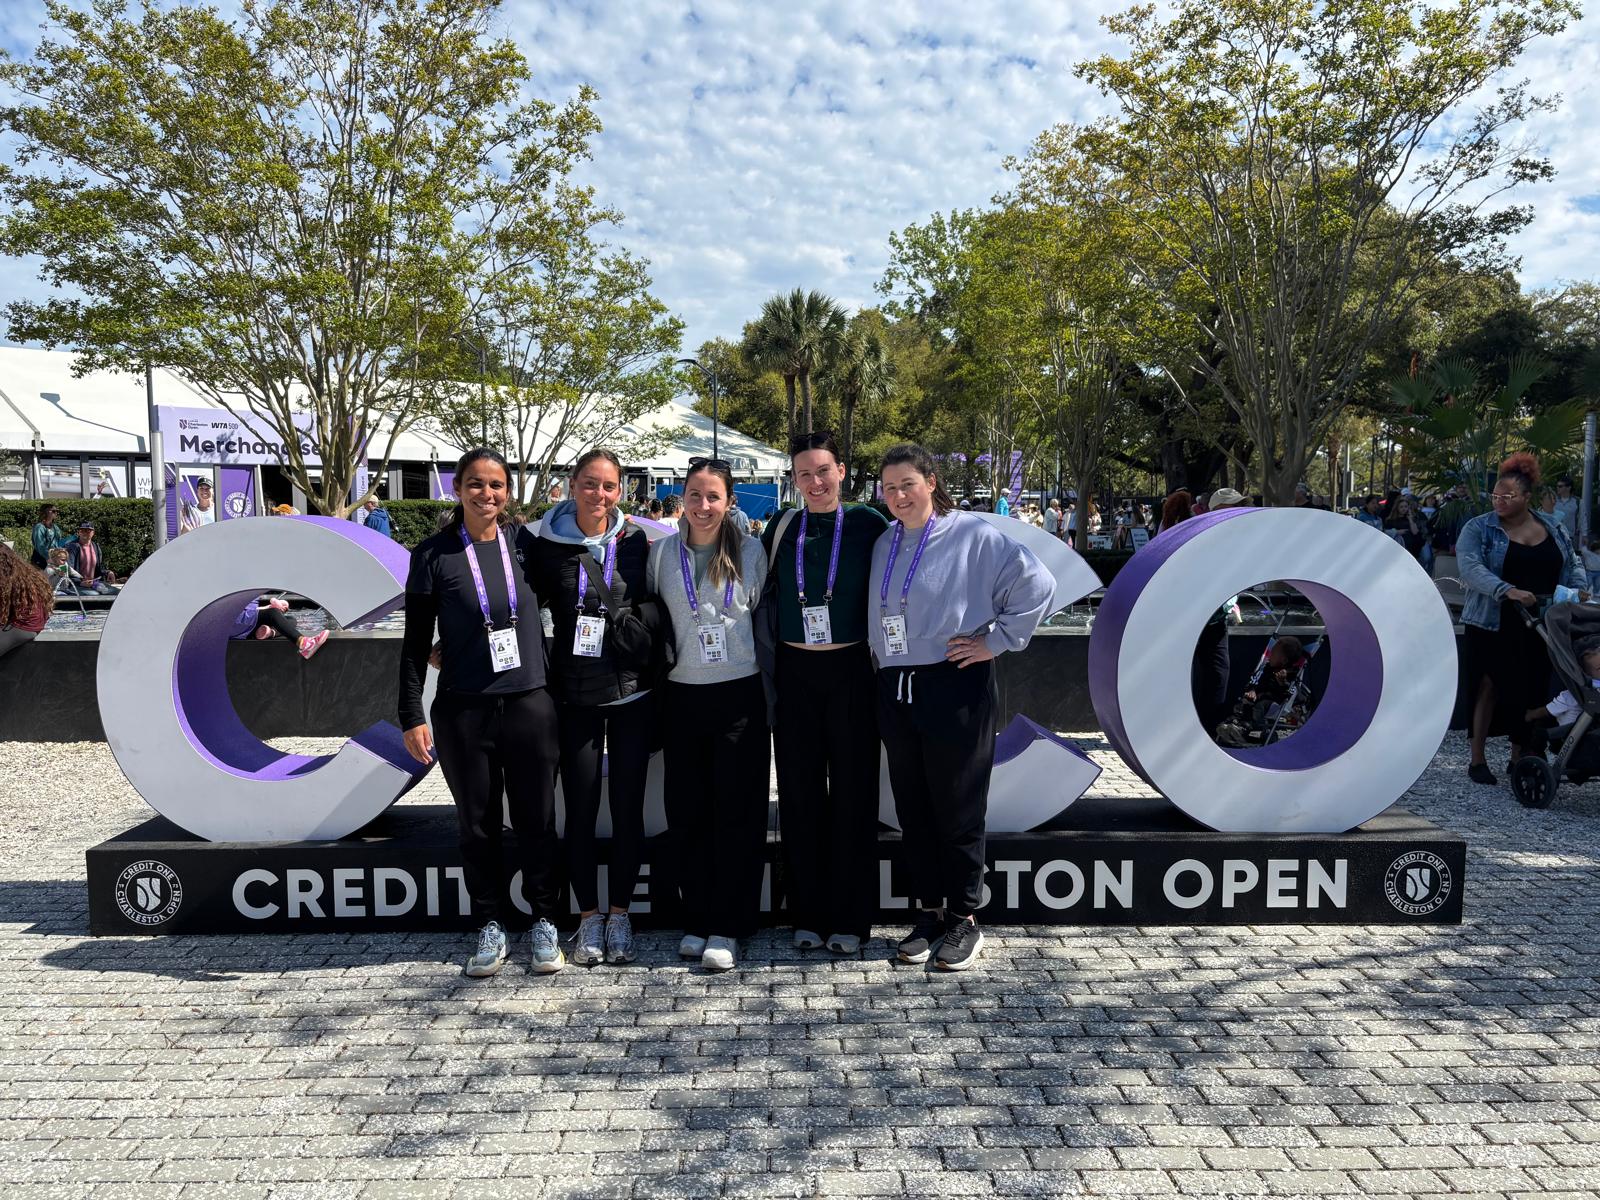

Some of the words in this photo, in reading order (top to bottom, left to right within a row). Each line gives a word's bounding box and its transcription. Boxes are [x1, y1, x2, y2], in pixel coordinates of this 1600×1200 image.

[180, 434, 321, 456] Merchanse
[123, 862, 154, 880] CREDIT
[156, 864, 175, 881] ONE
[1393, 853, 1425, 870] CREDIT
[1428, 855, 1445, 871] ONE
[232, 867, 471, 919] CREDIT
[1162, 858, 1348, 909] OPEN
[1386, 880, 1434, 913] CHARLESTON
[1435, 881, 1449, 904] OEN
[166, 890, 180, 914] OPEN
